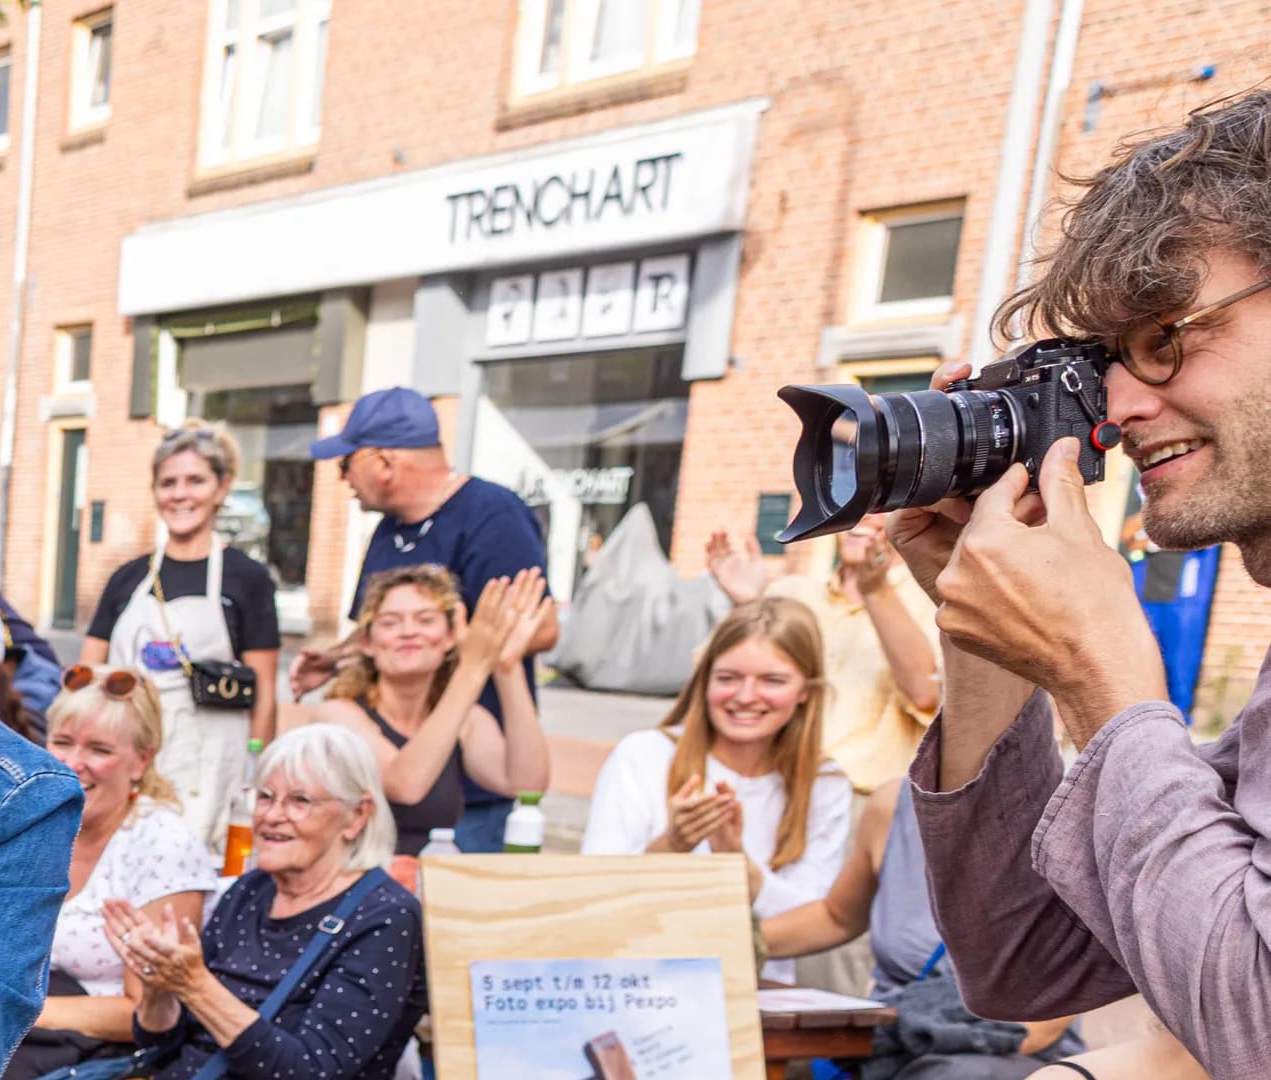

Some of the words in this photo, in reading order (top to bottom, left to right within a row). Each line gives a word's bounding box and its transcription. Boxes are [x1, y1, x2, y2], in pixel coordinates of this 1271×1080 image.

[446, 153, 682, 244] TRENCHART
[483, 976, 493, 991] 5
[502, 976, 543, 993] sept
[592, 974, 611, 989] 12
[619, 974, 651, 989] okt
[484, 995, 527, 1011] Foto
[535, 997, 578, 1013] expo
[585, 995, 617, 1013] bij
[624, 995, 678, 1011] Pexpo
